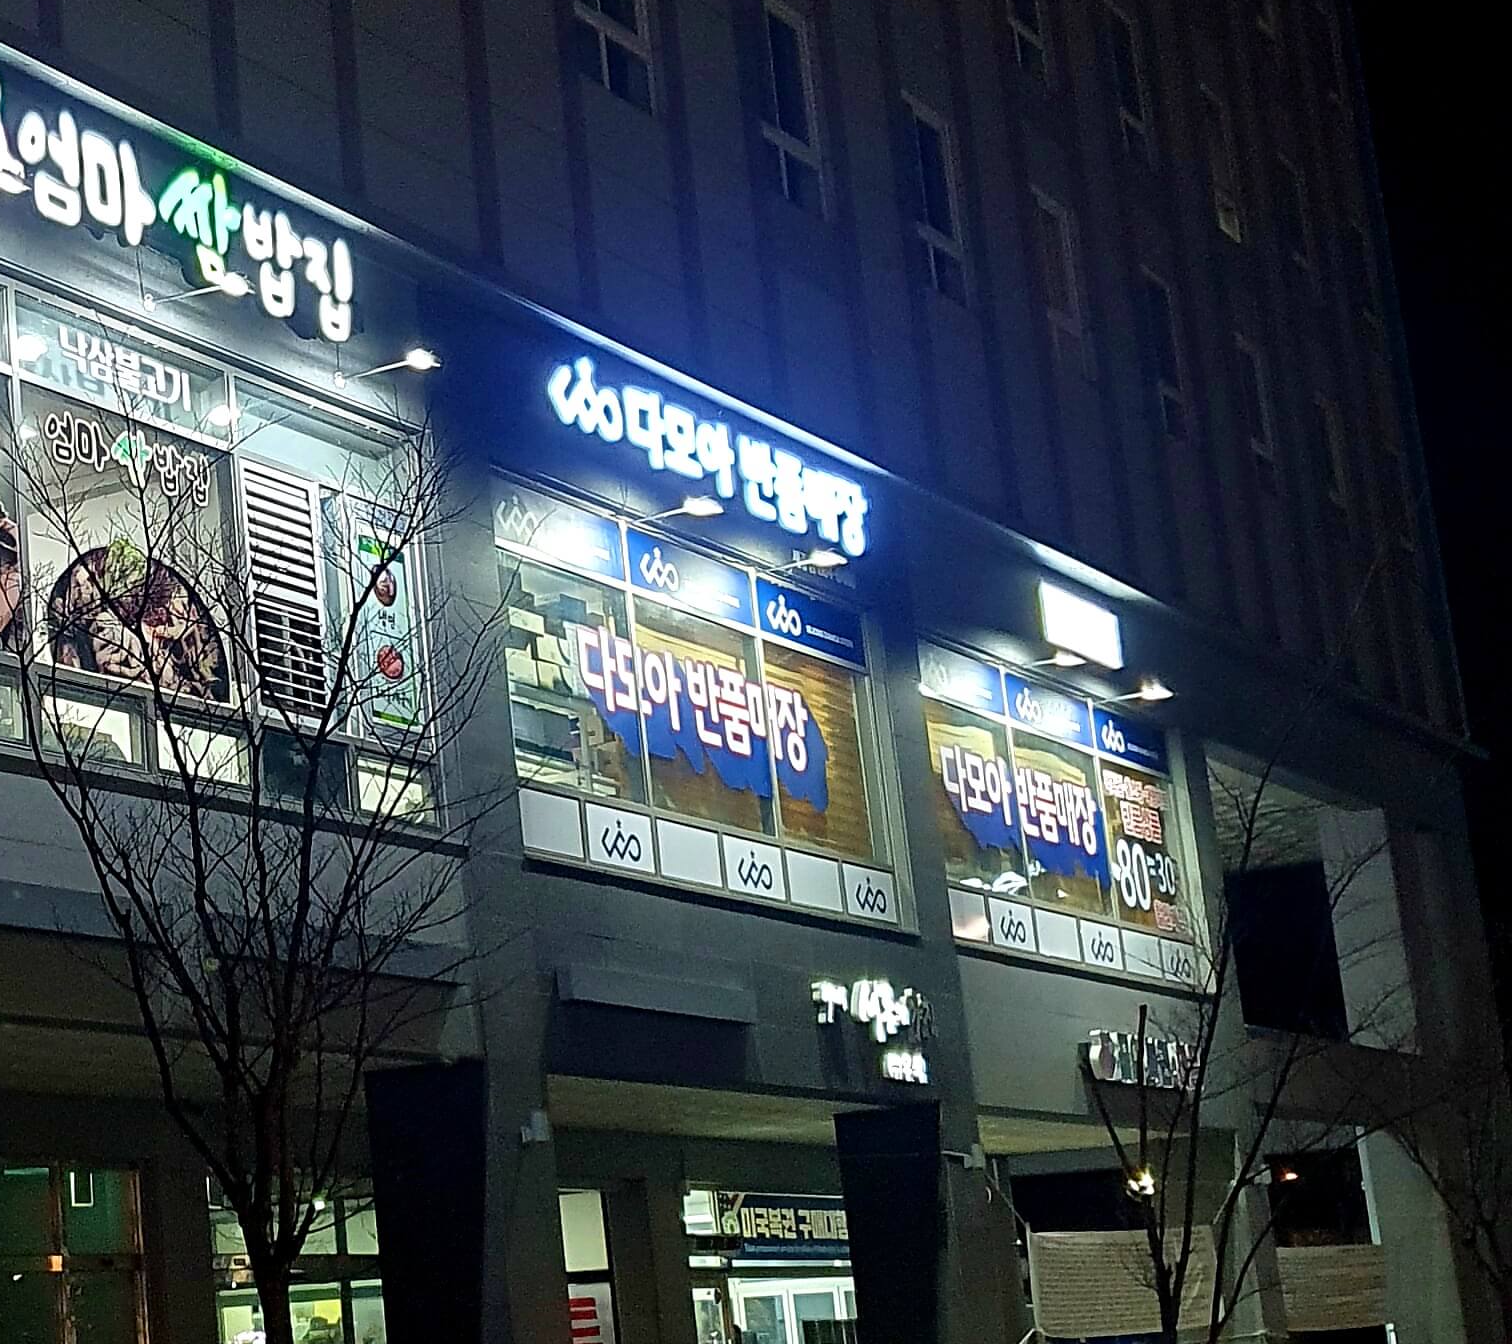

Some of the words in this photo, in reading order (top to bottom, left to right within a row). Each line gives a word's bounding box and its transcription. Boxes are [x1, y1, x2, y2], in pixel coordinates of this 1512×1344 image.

[622, 386, 735, 498] 다모아
[576, 624, 681, 732] 다모아
[685, 657, 808, 773] 반품매장
[940, 744, 1013, 827] 다모아
[1016, 767, 1097, 856] 반품매장
